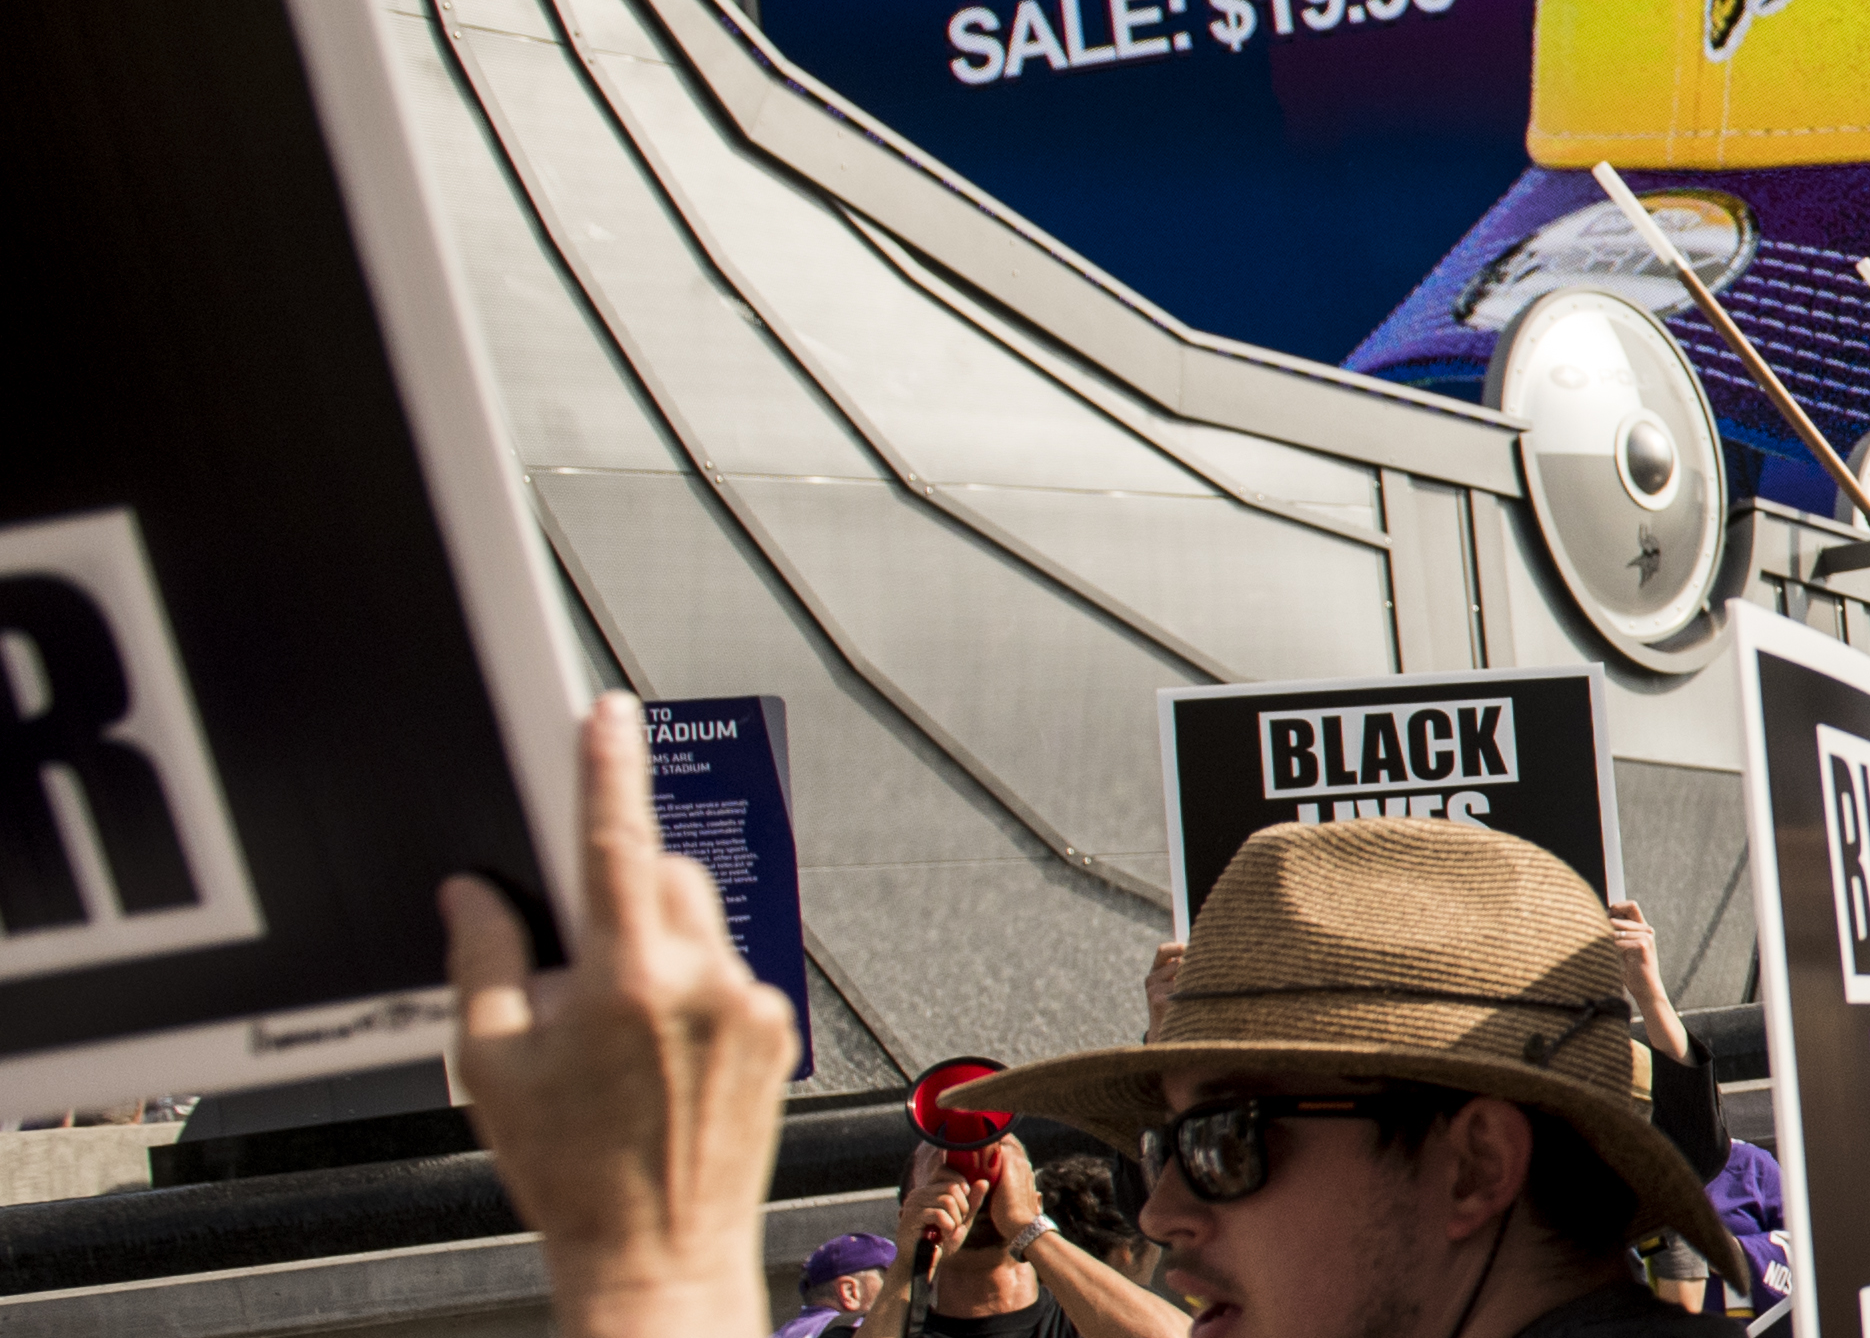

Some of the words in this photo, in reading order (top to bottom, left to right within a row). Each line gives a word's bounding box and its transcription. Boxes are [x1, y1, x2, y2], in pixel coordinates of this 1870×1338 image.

[649, 707, 672, 722] TO
[643, 719, 738, 743] TADIUM
[1269, 705, 1508, 790] BLACK
[661, 762, 711, 775] STADIUM
